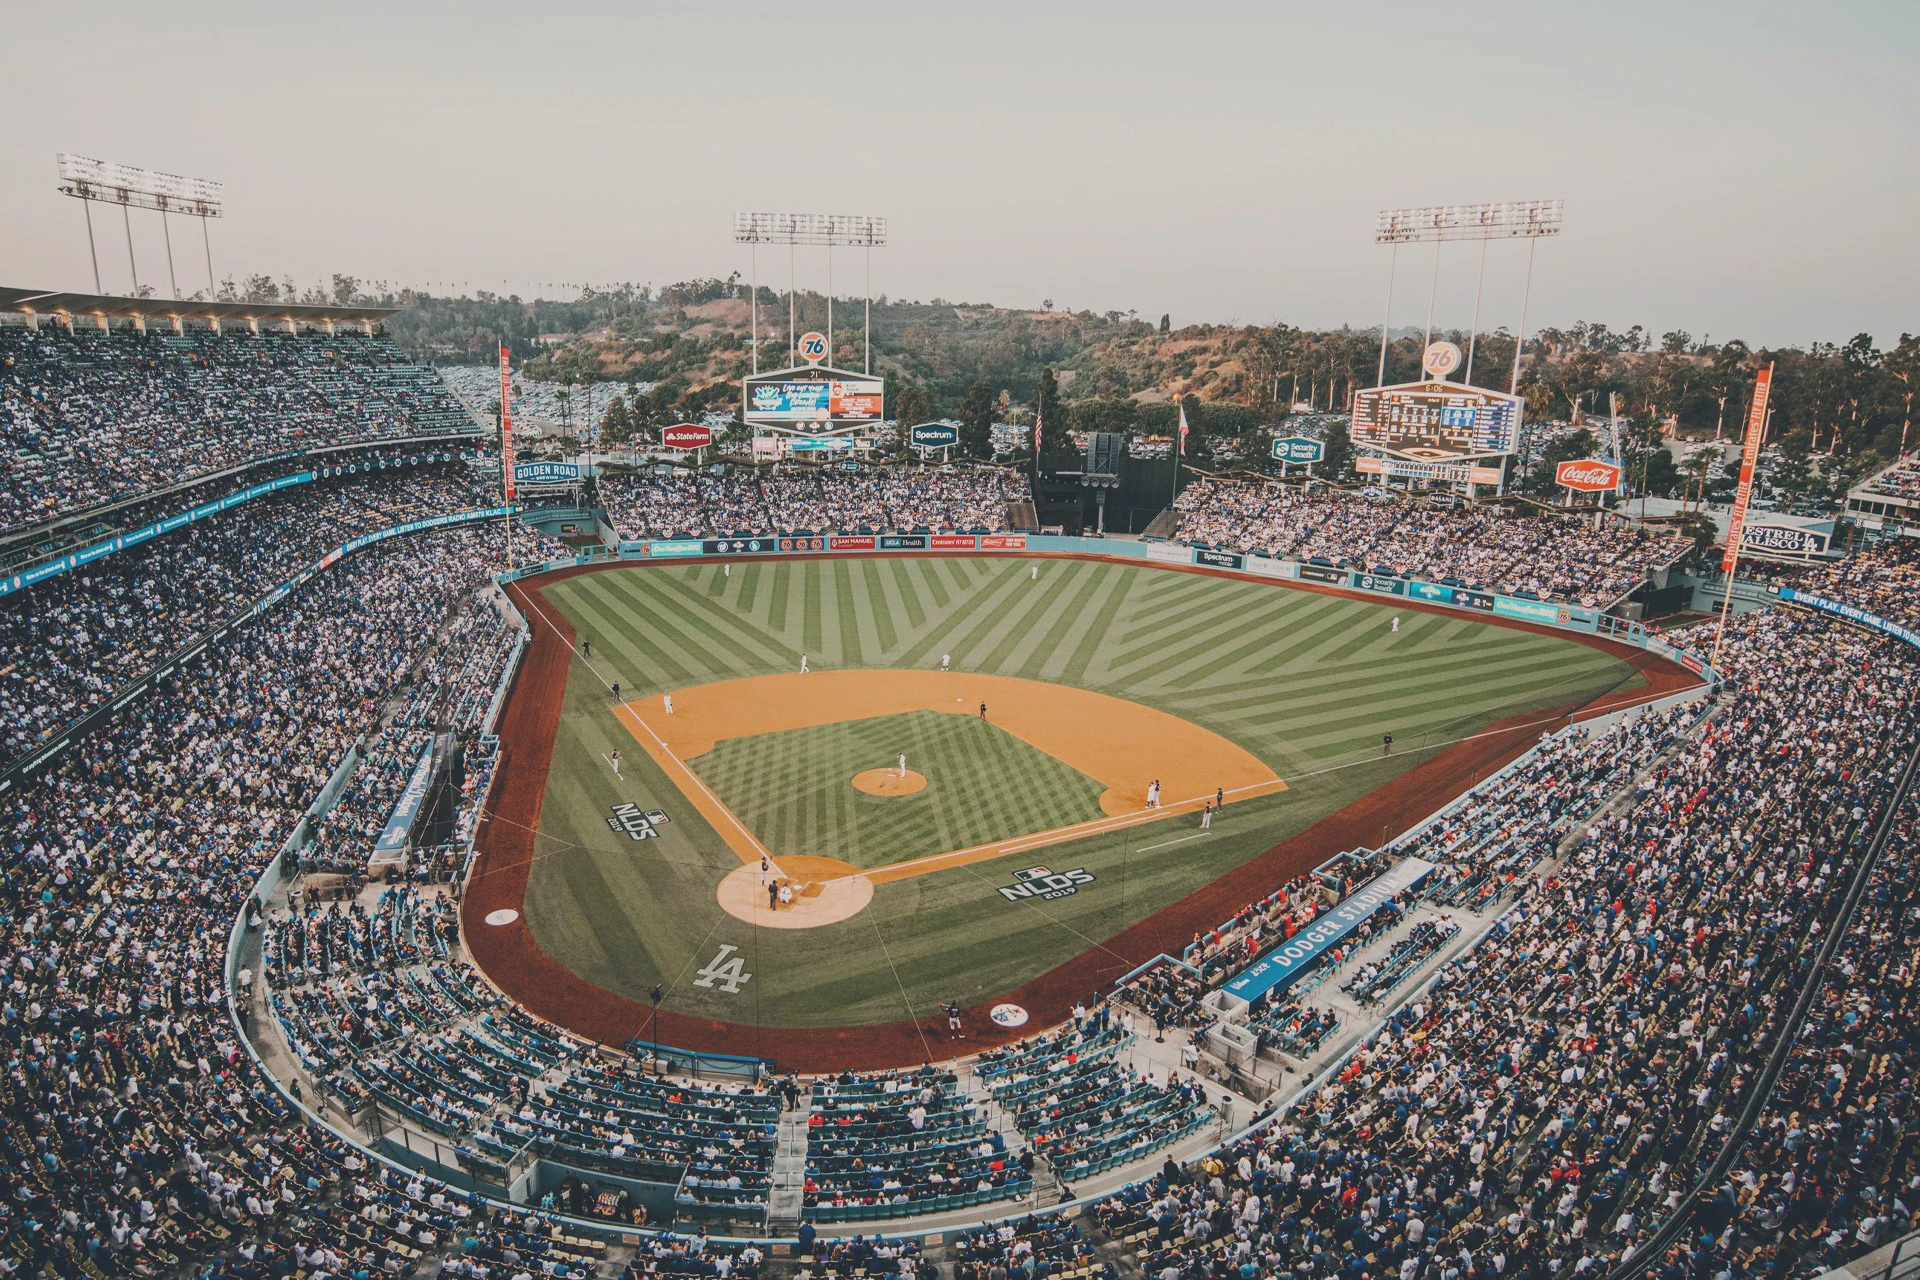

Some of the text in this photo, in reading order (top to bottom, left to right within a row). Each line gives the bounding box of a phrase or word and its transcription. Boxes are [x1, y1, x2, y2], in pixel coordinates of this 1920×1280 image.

[805, 338, 824, 354] 76
[1429, 349, 1452, 369] 76
[1425, 385, 1443, 393] 6:05
[1743, 381, 1767, 467] Emirates FLY BETTER
[915, 431, 952, 440] Spectrum
[1291, 443, 1318, 453] Security
[1291, 451, 1313, 459] Benefit
[517, 465, 577, 479] GOLDEN ROAD
[1561, 466, 1614, 485] Coca-Cola
[448, 513, 465, 522] RADIO
[1724, 516, 1741, 563] Emirates
[1203, 552, 1233, 562] Spectrum
[1374, 578, 1397, 588] Security
[1374, 584, 1393, 593] Benefit
[1794, 592, 1819, 608] EVERY
[1819, 598, 1840, 612] PLAY.
[1840, 603, 1862, 620] EVERY
[1883, 618, 1903, 635] LISTEN
[1902, 628, 1910, 638] TO
[608, 817, 623, 832] 2019
[612, 803, 657, 840] NLDS
[999, 869, 1095, 901] NLDS
[1044, 888, 1075, 900] 2019
[1272, 877, 1401, 967] DODGER STADIUM
[692, 944, 752, 994] LA
